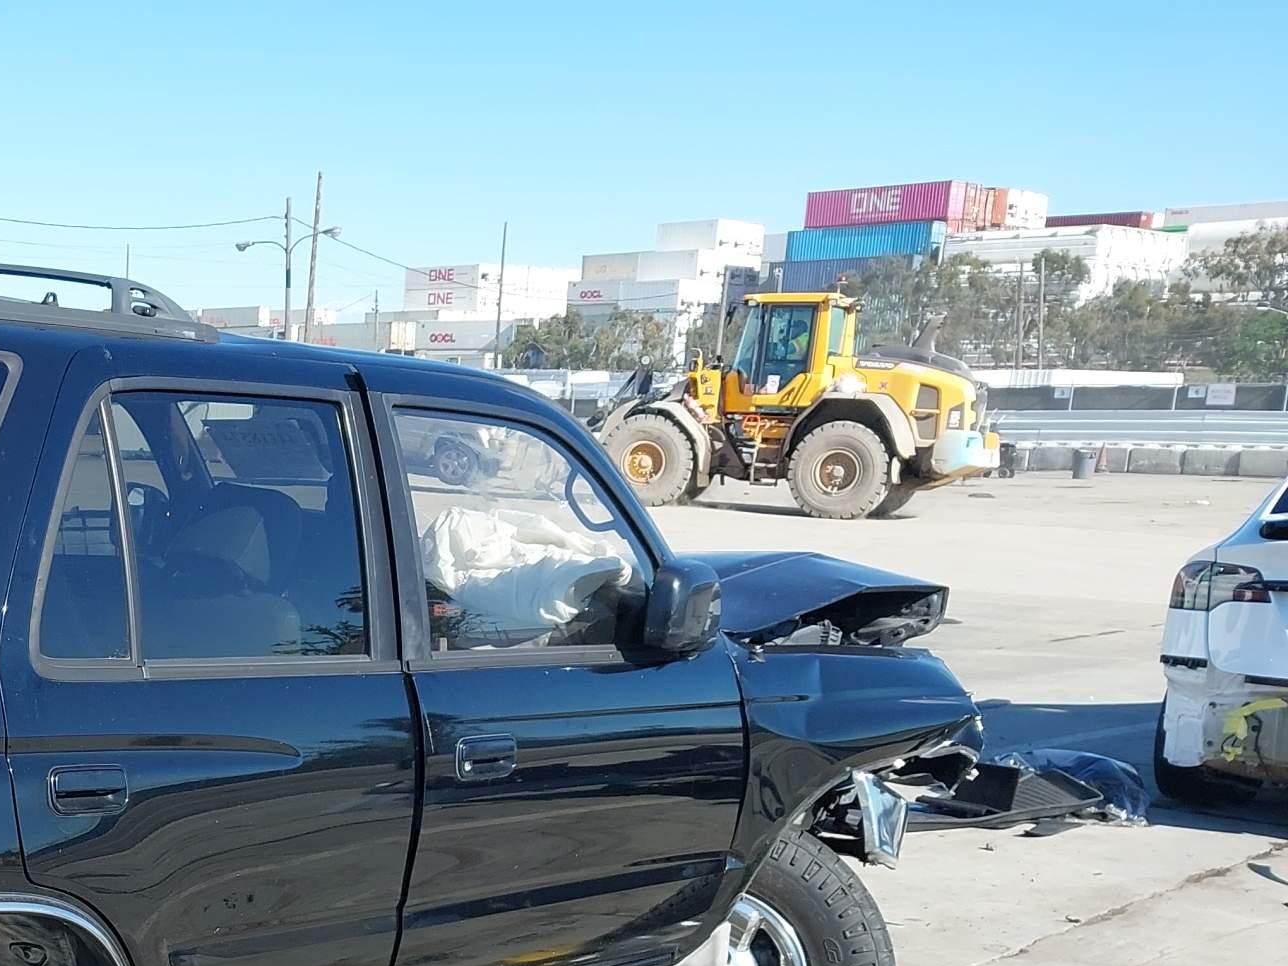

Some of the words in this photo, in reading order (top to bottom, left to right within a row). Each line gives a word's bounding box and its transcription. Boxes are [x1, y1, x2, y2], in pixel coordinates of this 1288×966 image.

[850, 189, 901, 215] ONE
[428, 268, 455, 282] ONE
[427, 292, 454, 306] ONE
[430, 332, 457, 343] OOCL
